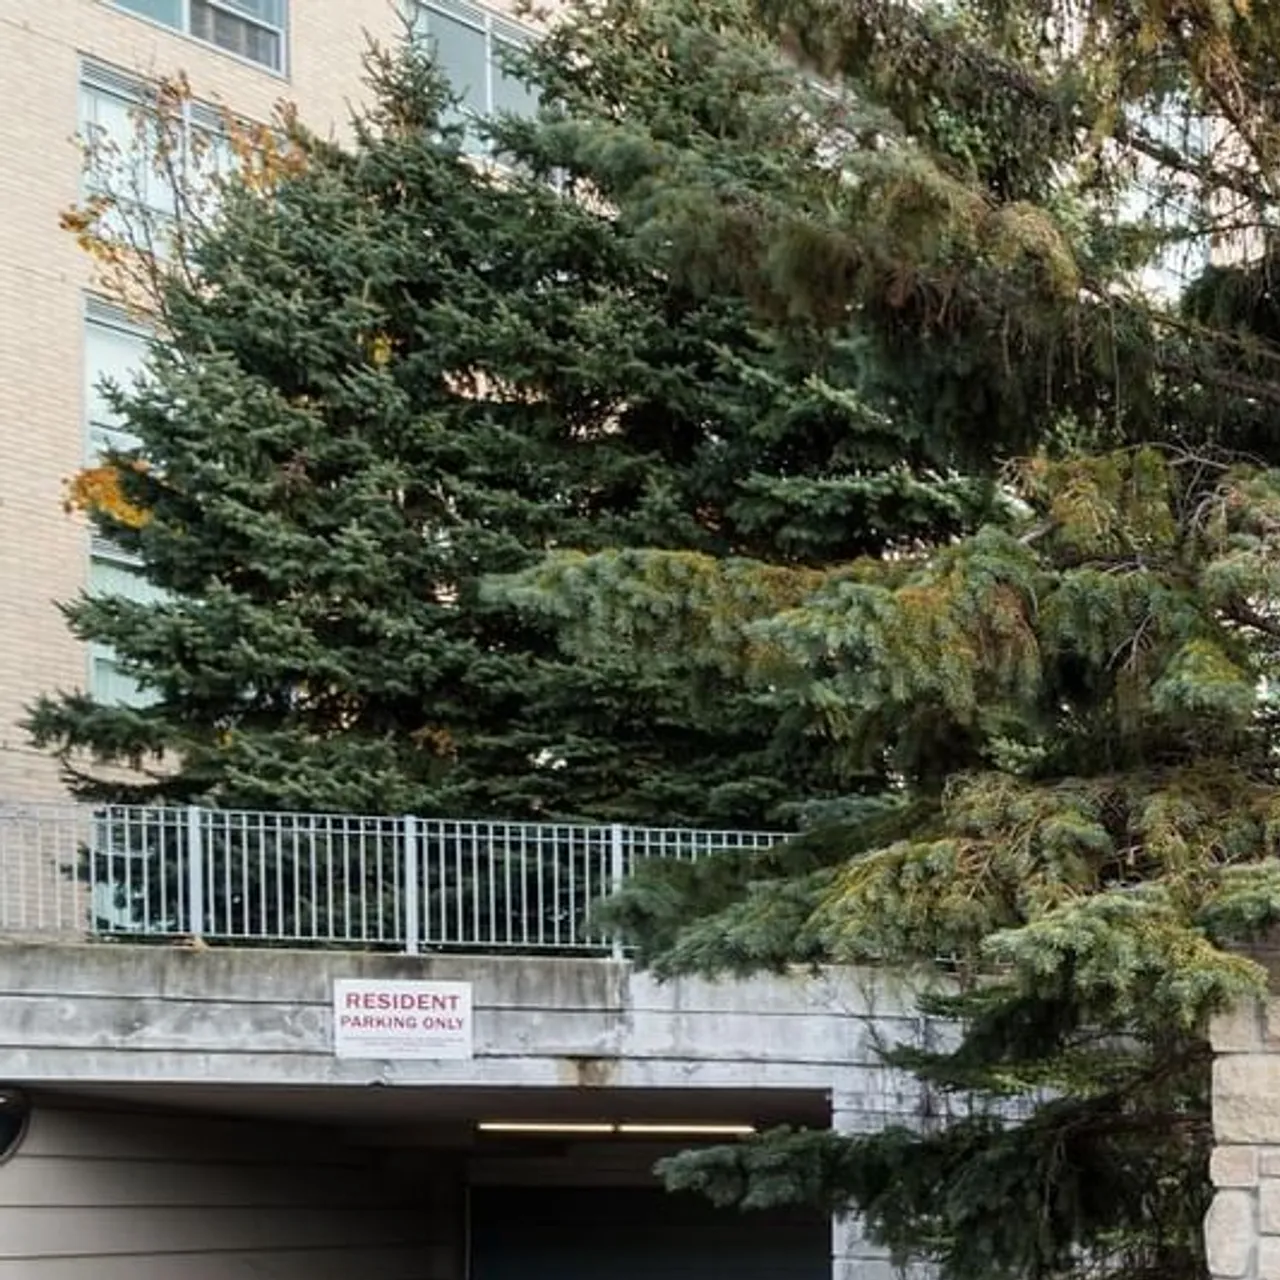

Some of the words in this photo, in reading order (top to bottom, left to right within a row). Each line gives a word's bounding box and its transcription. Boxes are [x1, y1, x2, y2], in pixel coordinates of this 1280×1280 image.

[346, 993, 460, 1010] RESIDENT
[340, 1015, 417, 1029] PARKING
[423, 1016, 464, 1030] ONLY
